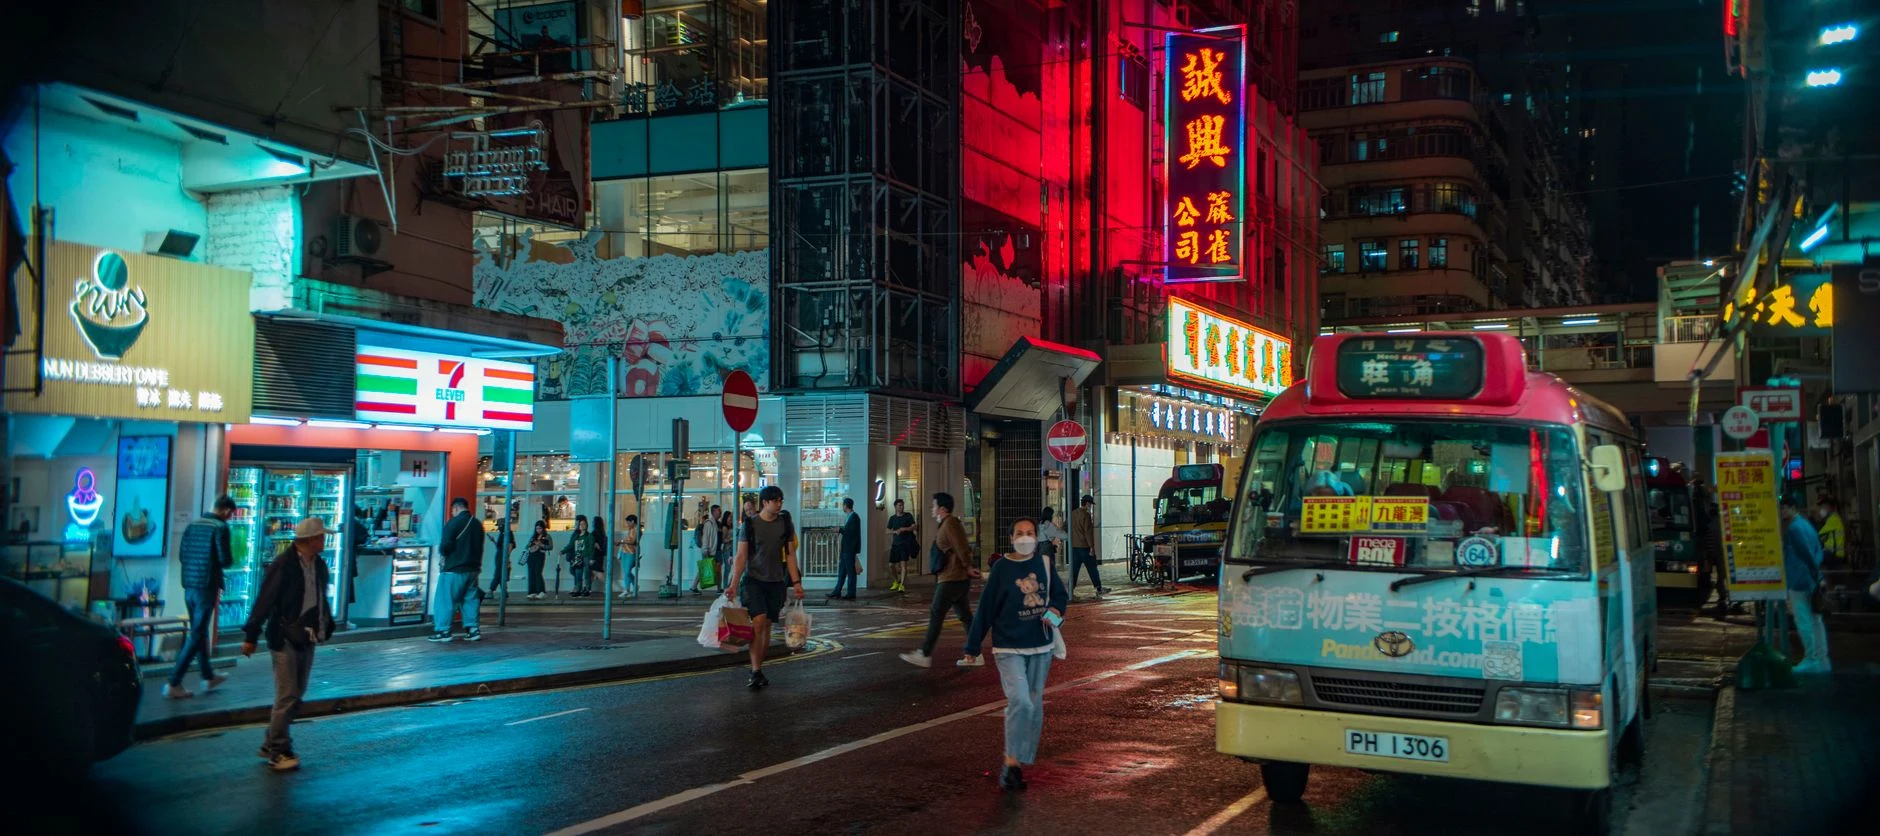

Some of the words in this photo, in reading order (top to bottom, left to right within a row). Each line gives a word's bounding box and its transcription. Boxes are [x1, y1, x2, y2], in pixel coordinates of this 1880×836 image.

[540, 192, 578, 219] HAIR
[1377, 506, 1424, 522] 九龍灣
[1358, 538, 1396, 548] mega
[1469, 547, 1487, 562] 64
[1350, 732, 1378, 753] PH
[1392, 735, 1444, 758] 1306
